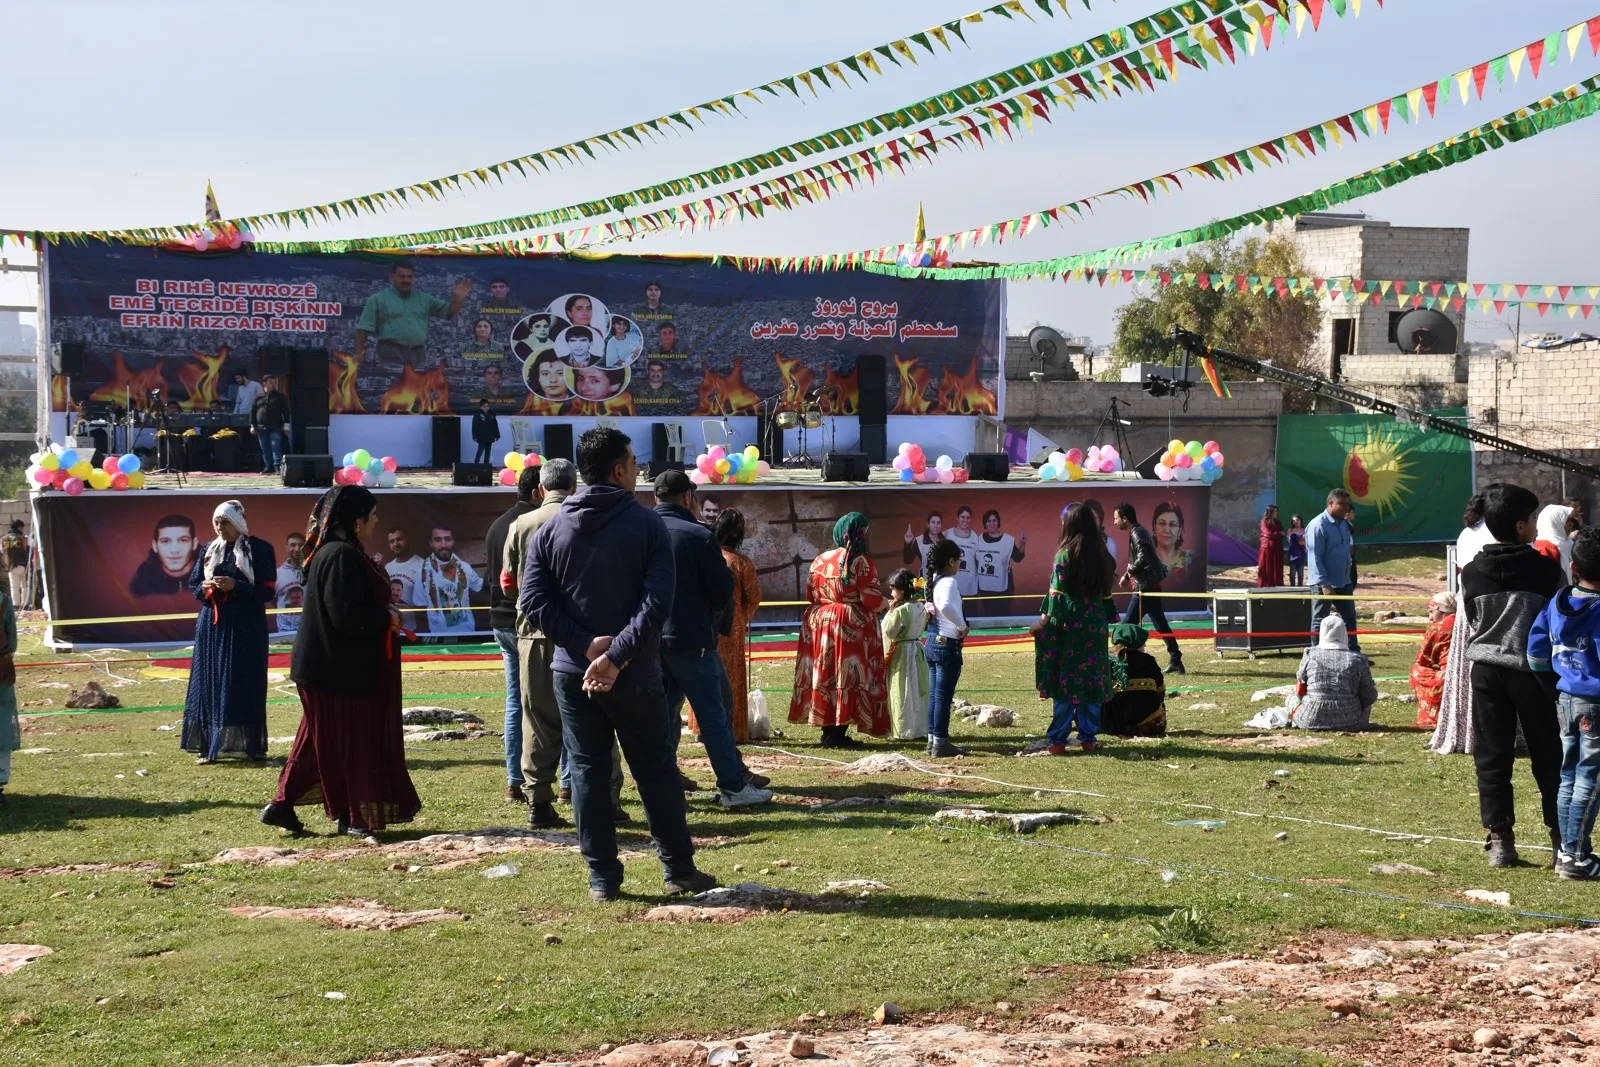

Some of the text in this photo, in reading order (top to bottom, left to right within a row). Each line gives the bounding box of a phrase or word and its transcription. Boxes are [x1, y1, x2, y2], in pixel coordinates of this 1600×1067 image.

[136, 279, 317, 299] BI RIHÊ NEWROZÊ
[109, 295, 341, 317] EMÊ TECRÎDÊ BIŞKÎNIN
[812, 297, 898, 319] بروح نوروز
[188, 315, 266, 331] RIZGAR
[271, 317, 327, 333] BIKIN
[750, 318, 959, 342] سنحطم العزلة ونحرر عفرين
